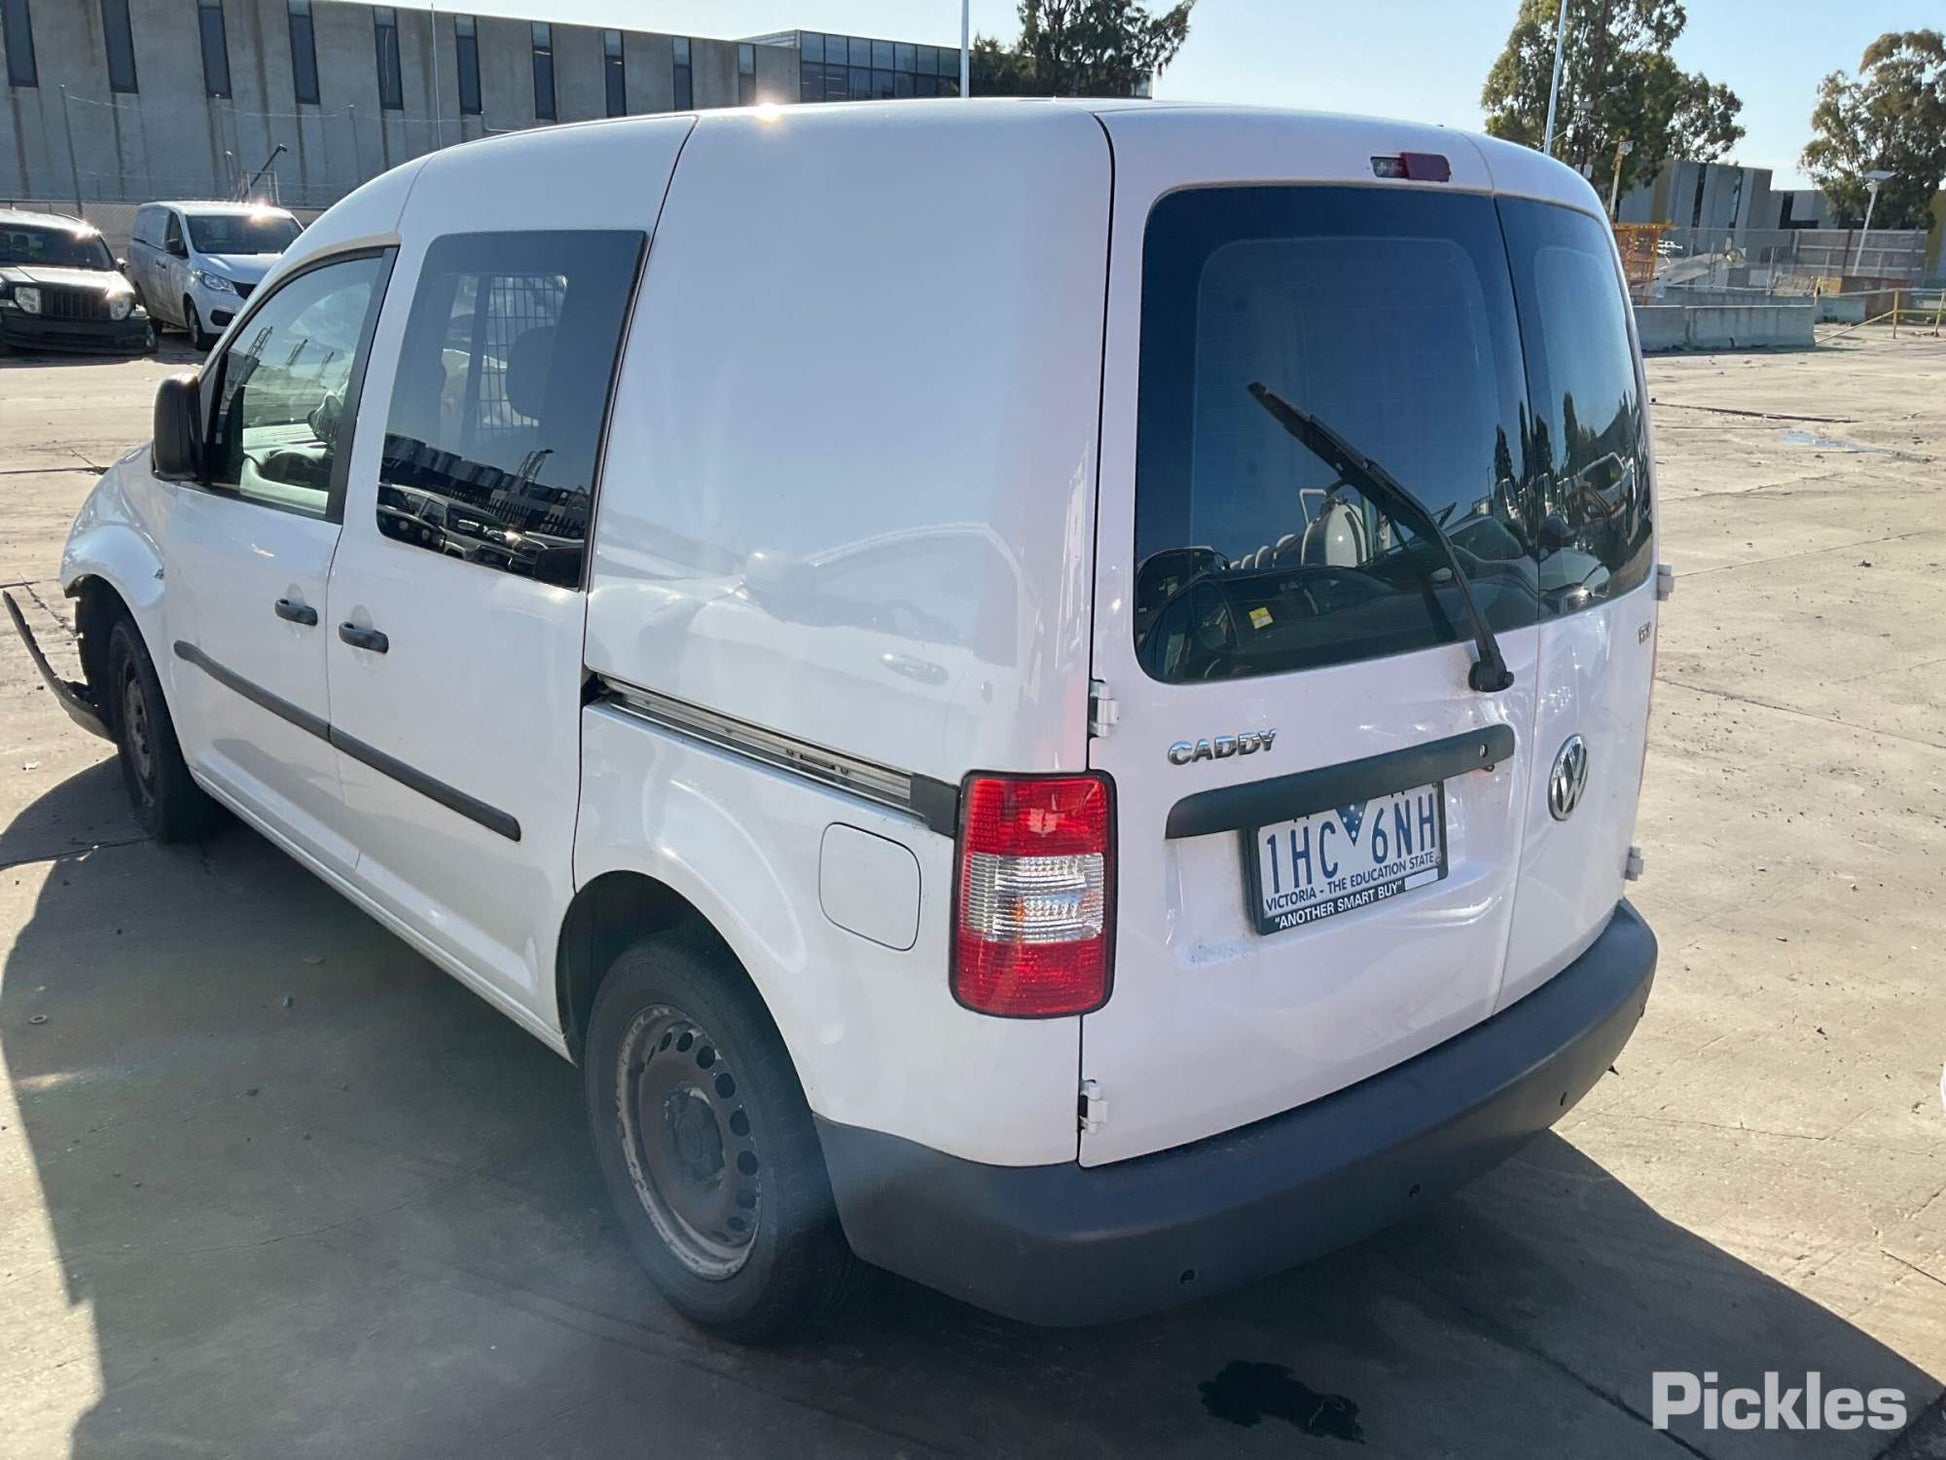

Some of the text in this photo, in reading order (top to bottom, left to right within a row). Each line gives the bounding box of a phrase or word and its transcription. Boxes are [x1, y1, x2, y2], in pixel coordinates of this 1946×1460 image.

[1167, 728, 1277, 765] CADDY
[1267, 793, 1436, 894] 1HC 6NH
[1265, 886, 1317, 912] VICTORIA
[1327, 876, 1348, 894] THE
[1350, 860, 1407, 888] EDUCATION
[1409, 851, 1434, 870] STATE
[1337, 889, 1375, 912] SMART
